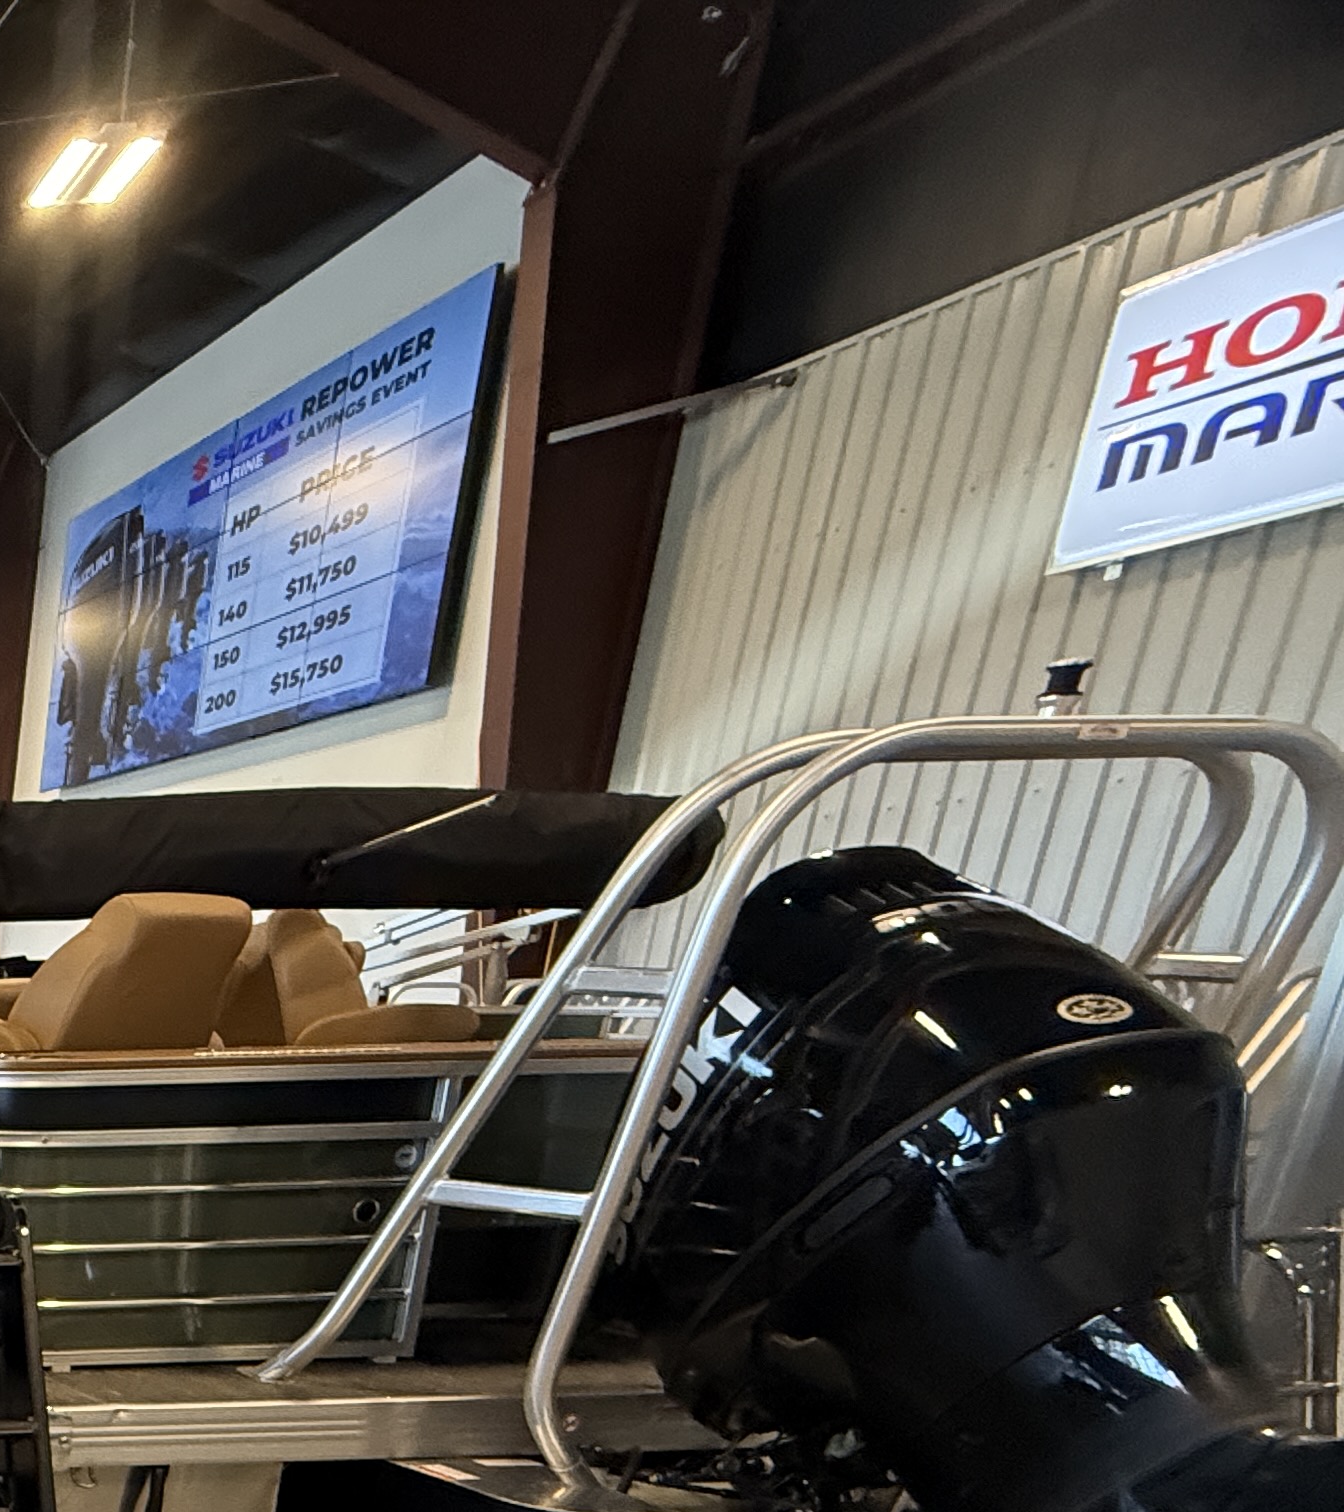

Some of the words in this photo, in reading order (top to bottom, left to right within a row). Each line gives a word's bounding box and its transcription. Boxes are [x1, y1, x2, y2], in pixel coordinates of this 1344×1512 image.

[1114, 274, 1344, 409] HO
[214, 408, 295, 468] SUZUKI
[300, 327, 436, 421] REPOWER
[295, 396, 367, 447] SAVINGS
[371, 360, 432, 406] EVENT
[209, 451, 267, 495] MARINE
[230, 504, 261, 537] HP
[299, 446, 376, 503] PRICE
[227, 556, 251, 582] 115
[288, 502, 369, 556] $10,499
[218, 601, 248, 627] 140
[285, 555, 357, 601] $11,750
[214, 646, 241, 670] 150
[276, 605, 352, 650] $12,995
[205, 689, 237, 714] 200
[269, 654, 344, 695] $15,750
